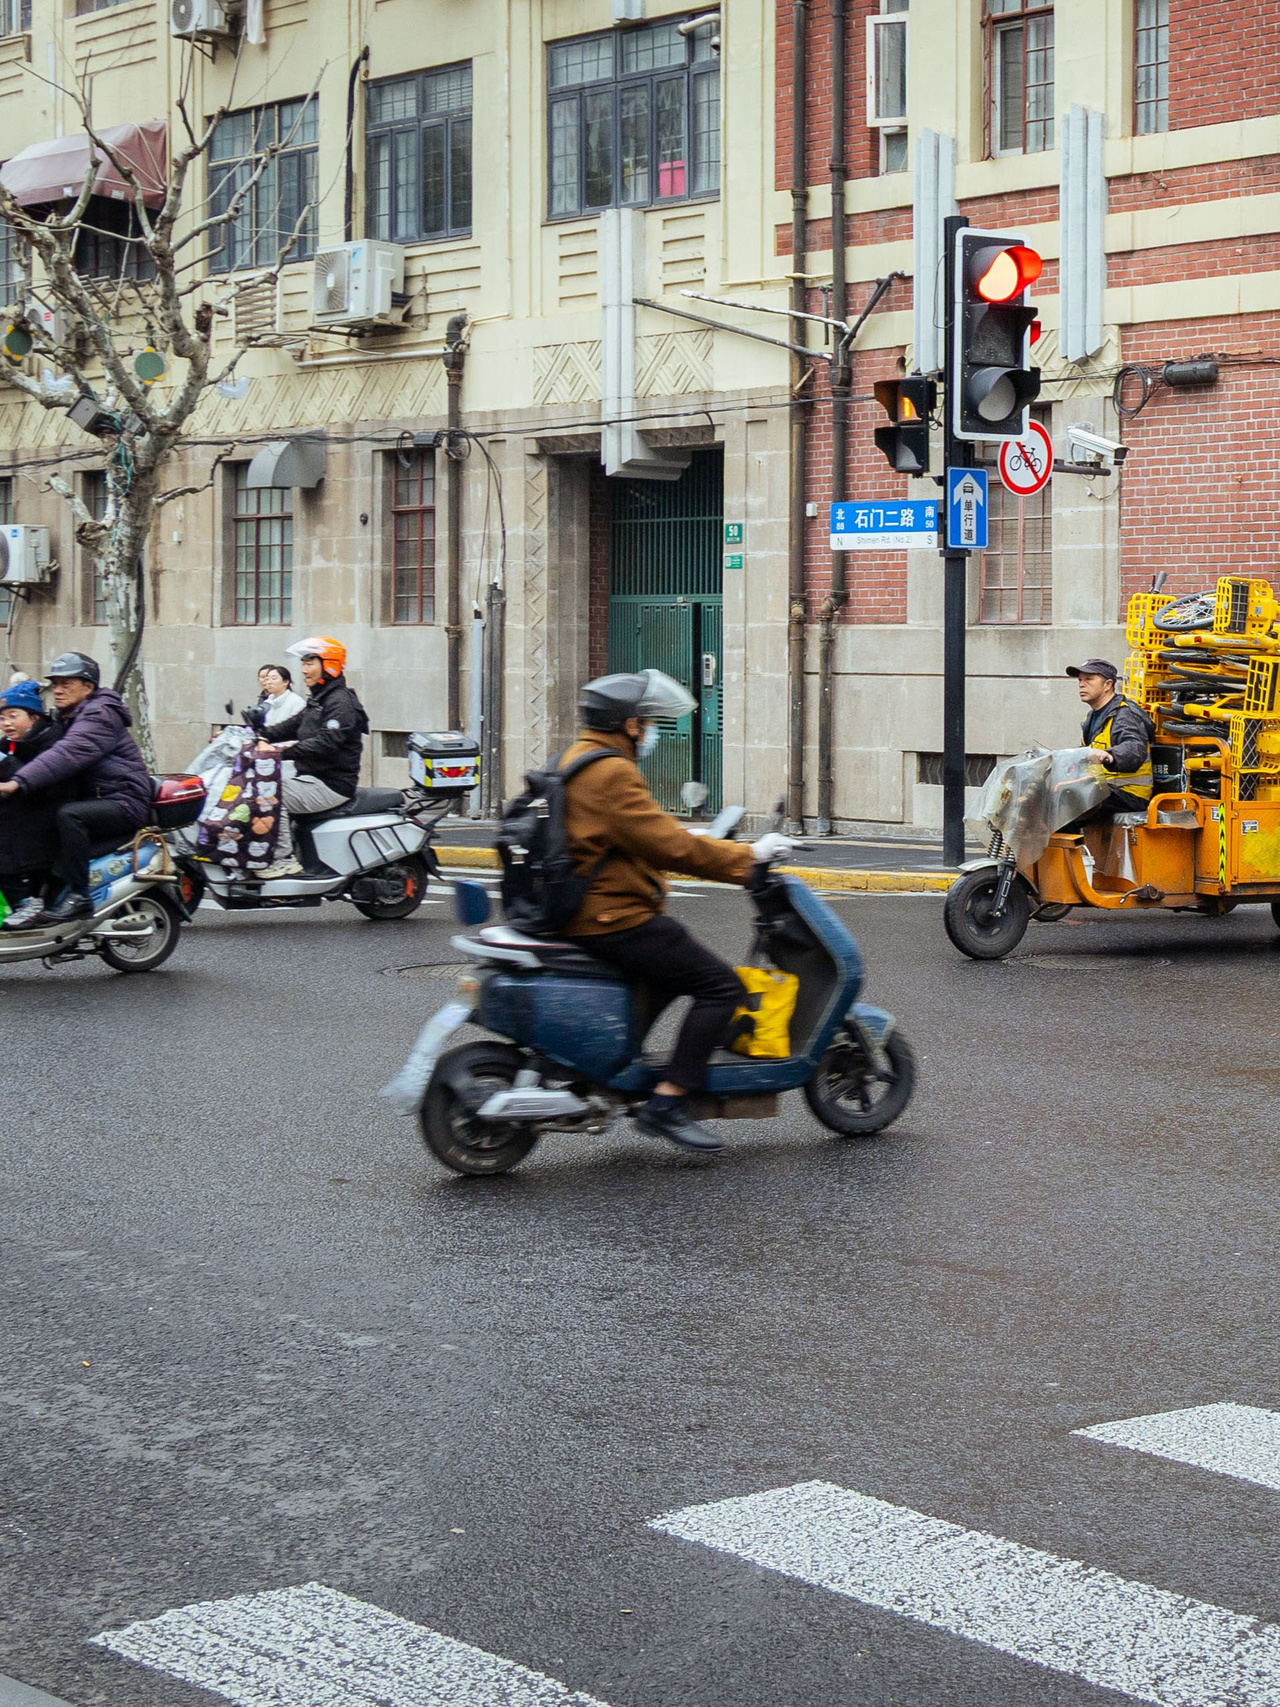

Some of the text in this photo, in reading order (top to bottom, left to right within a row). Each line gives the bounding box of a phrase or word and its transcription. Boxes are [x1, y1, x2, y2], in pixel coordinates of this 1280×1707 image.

[835, 508, 845, 520] 北
[924, 505, 935, 518] 南
[854, 507, 915, 529] 石门二路
[963, 499, 974, 541] 单行道
[925, 520, 935, 529] 50
[728, 525, 738, 536] 50
[836, 537, 843, 546] N
[926, 534, 934, 545] S
